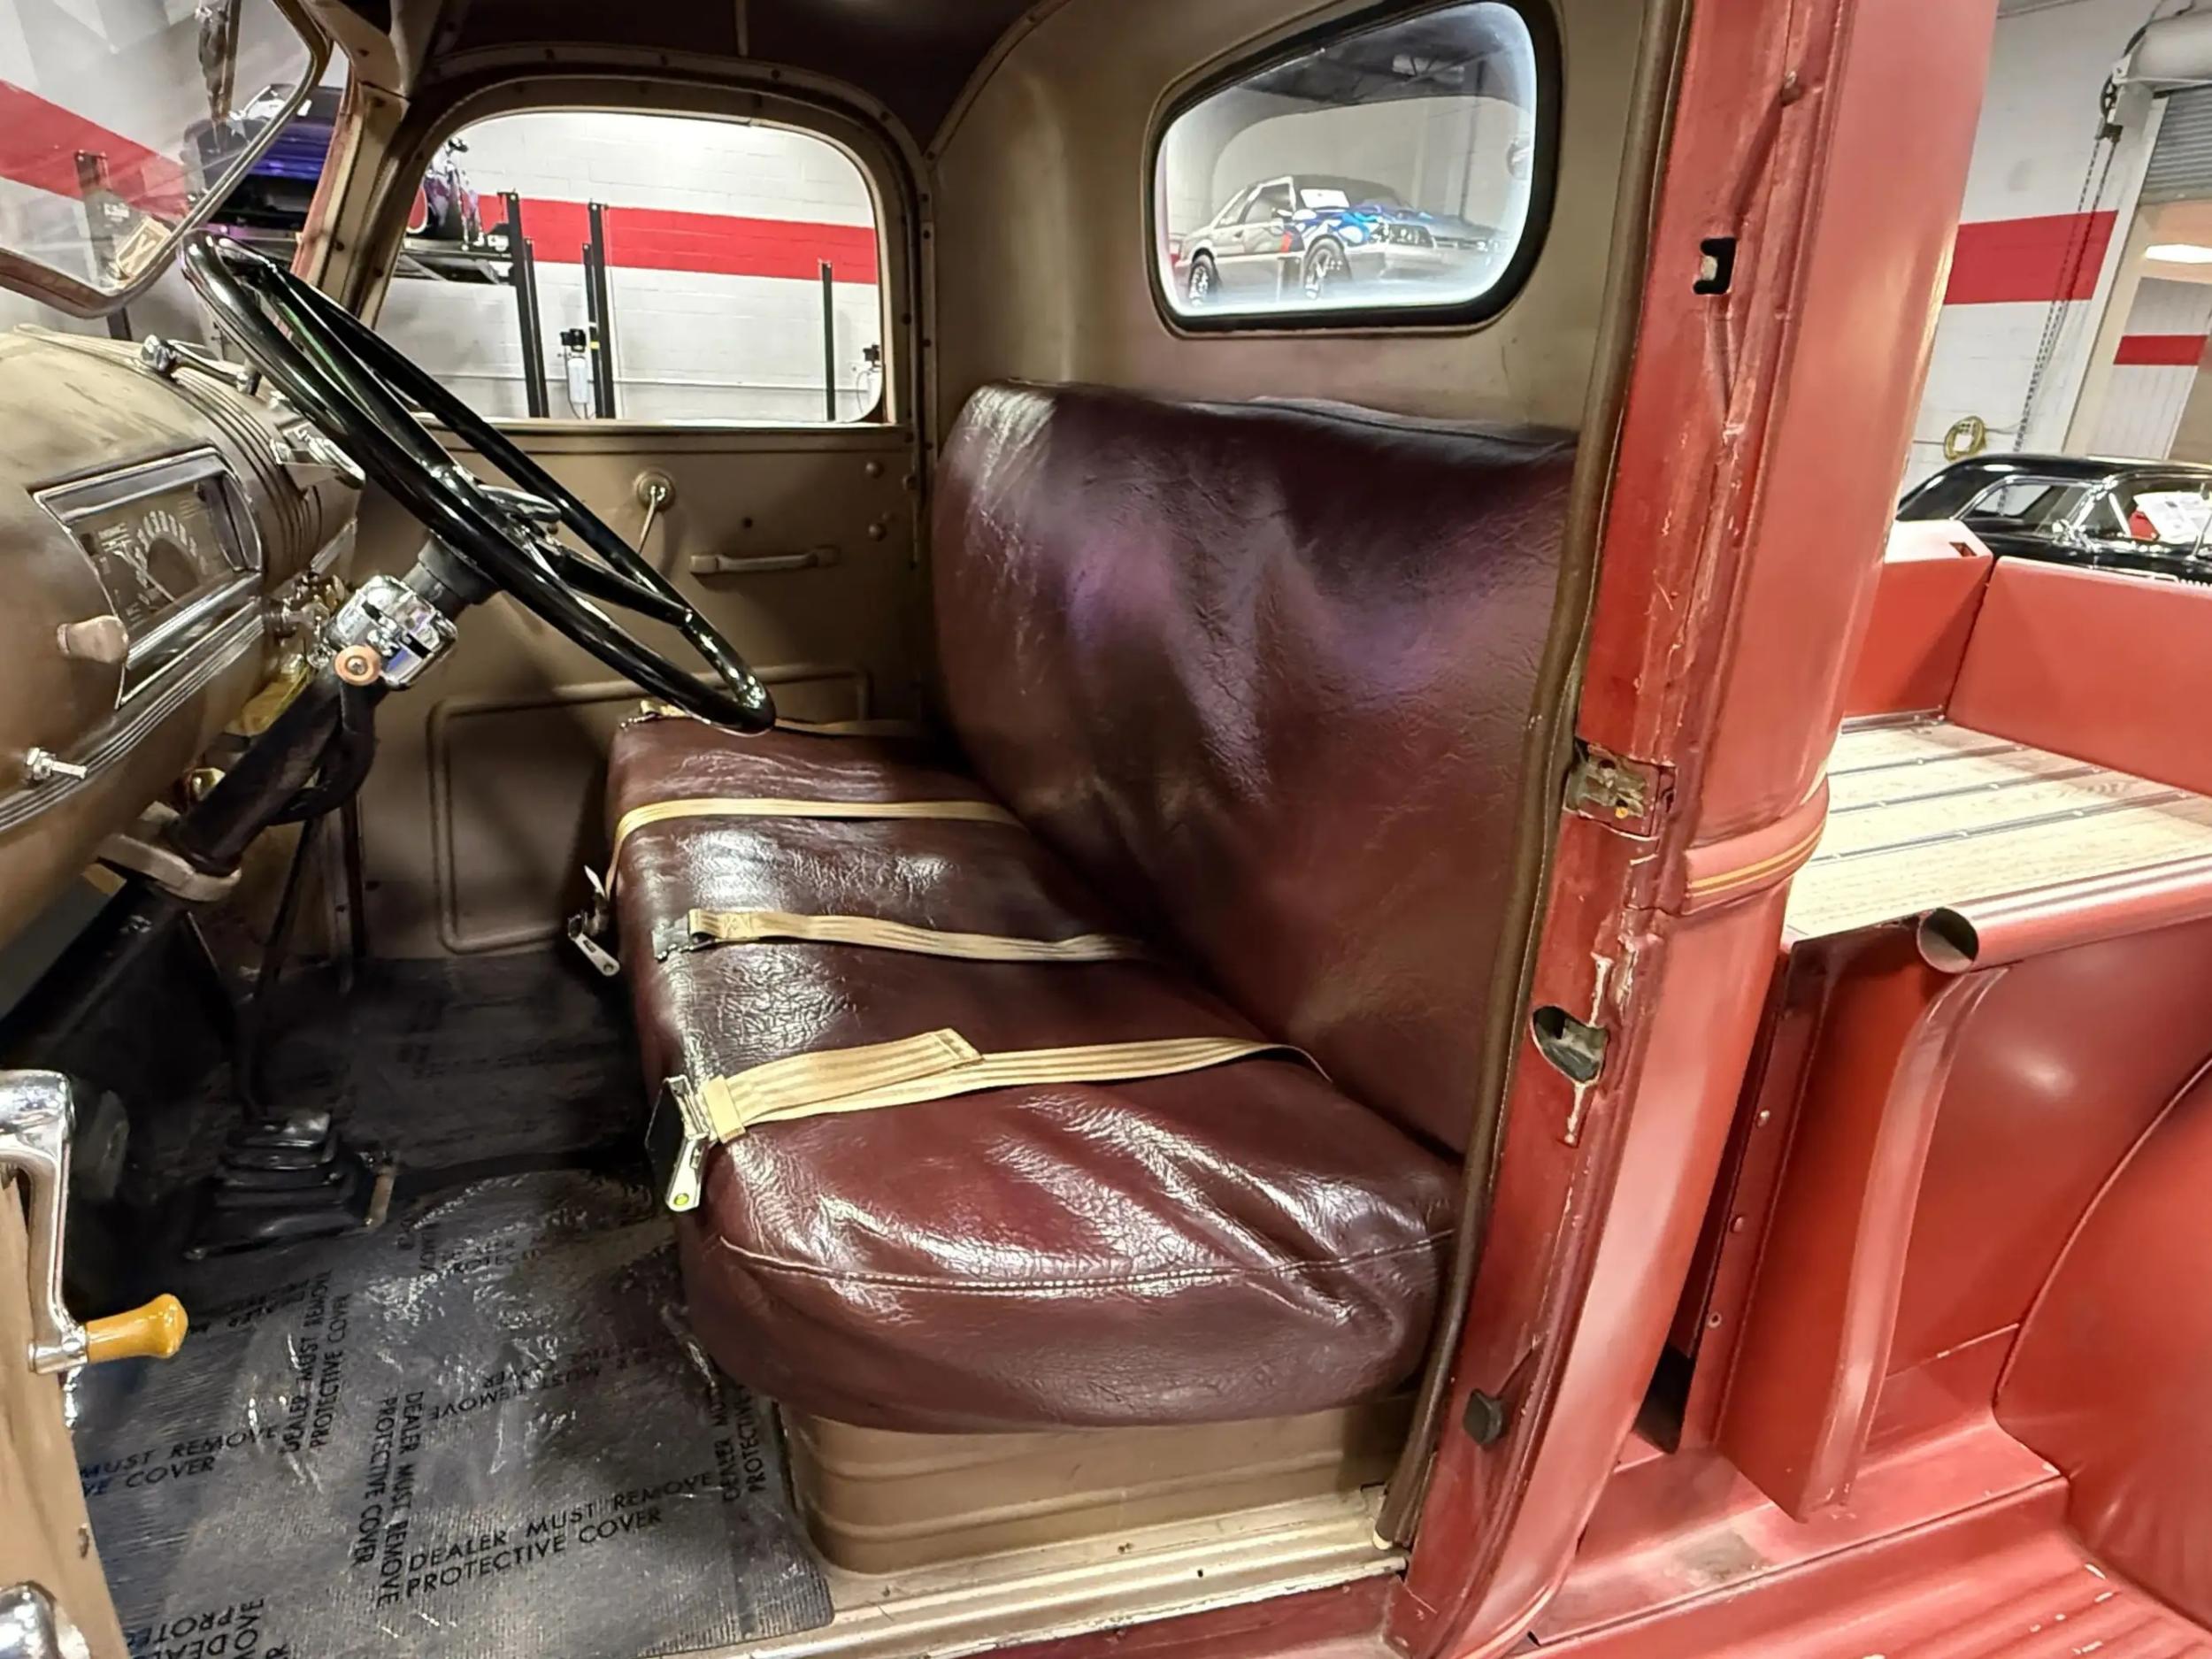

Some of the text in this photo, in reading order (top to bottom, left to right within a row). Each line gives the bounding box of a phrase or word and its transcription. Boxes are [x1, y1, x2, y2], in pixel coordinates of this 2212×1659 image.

[169, 1425, 278, 1459] REMOVE
[311, 1349, 344, 1448] PROTECTIVE
[126, 1455, 216, 1488] COVER
[351, 1396, 398, 1567] PROTECTIVE COVER
[377, 1391, 425, 1609] DEALER MUST REMOVE
[406, 1508, 662, 1598] PROTECTIVE COVER
[409, 1471, 712, 1573] DEALER MUST REMOVE
